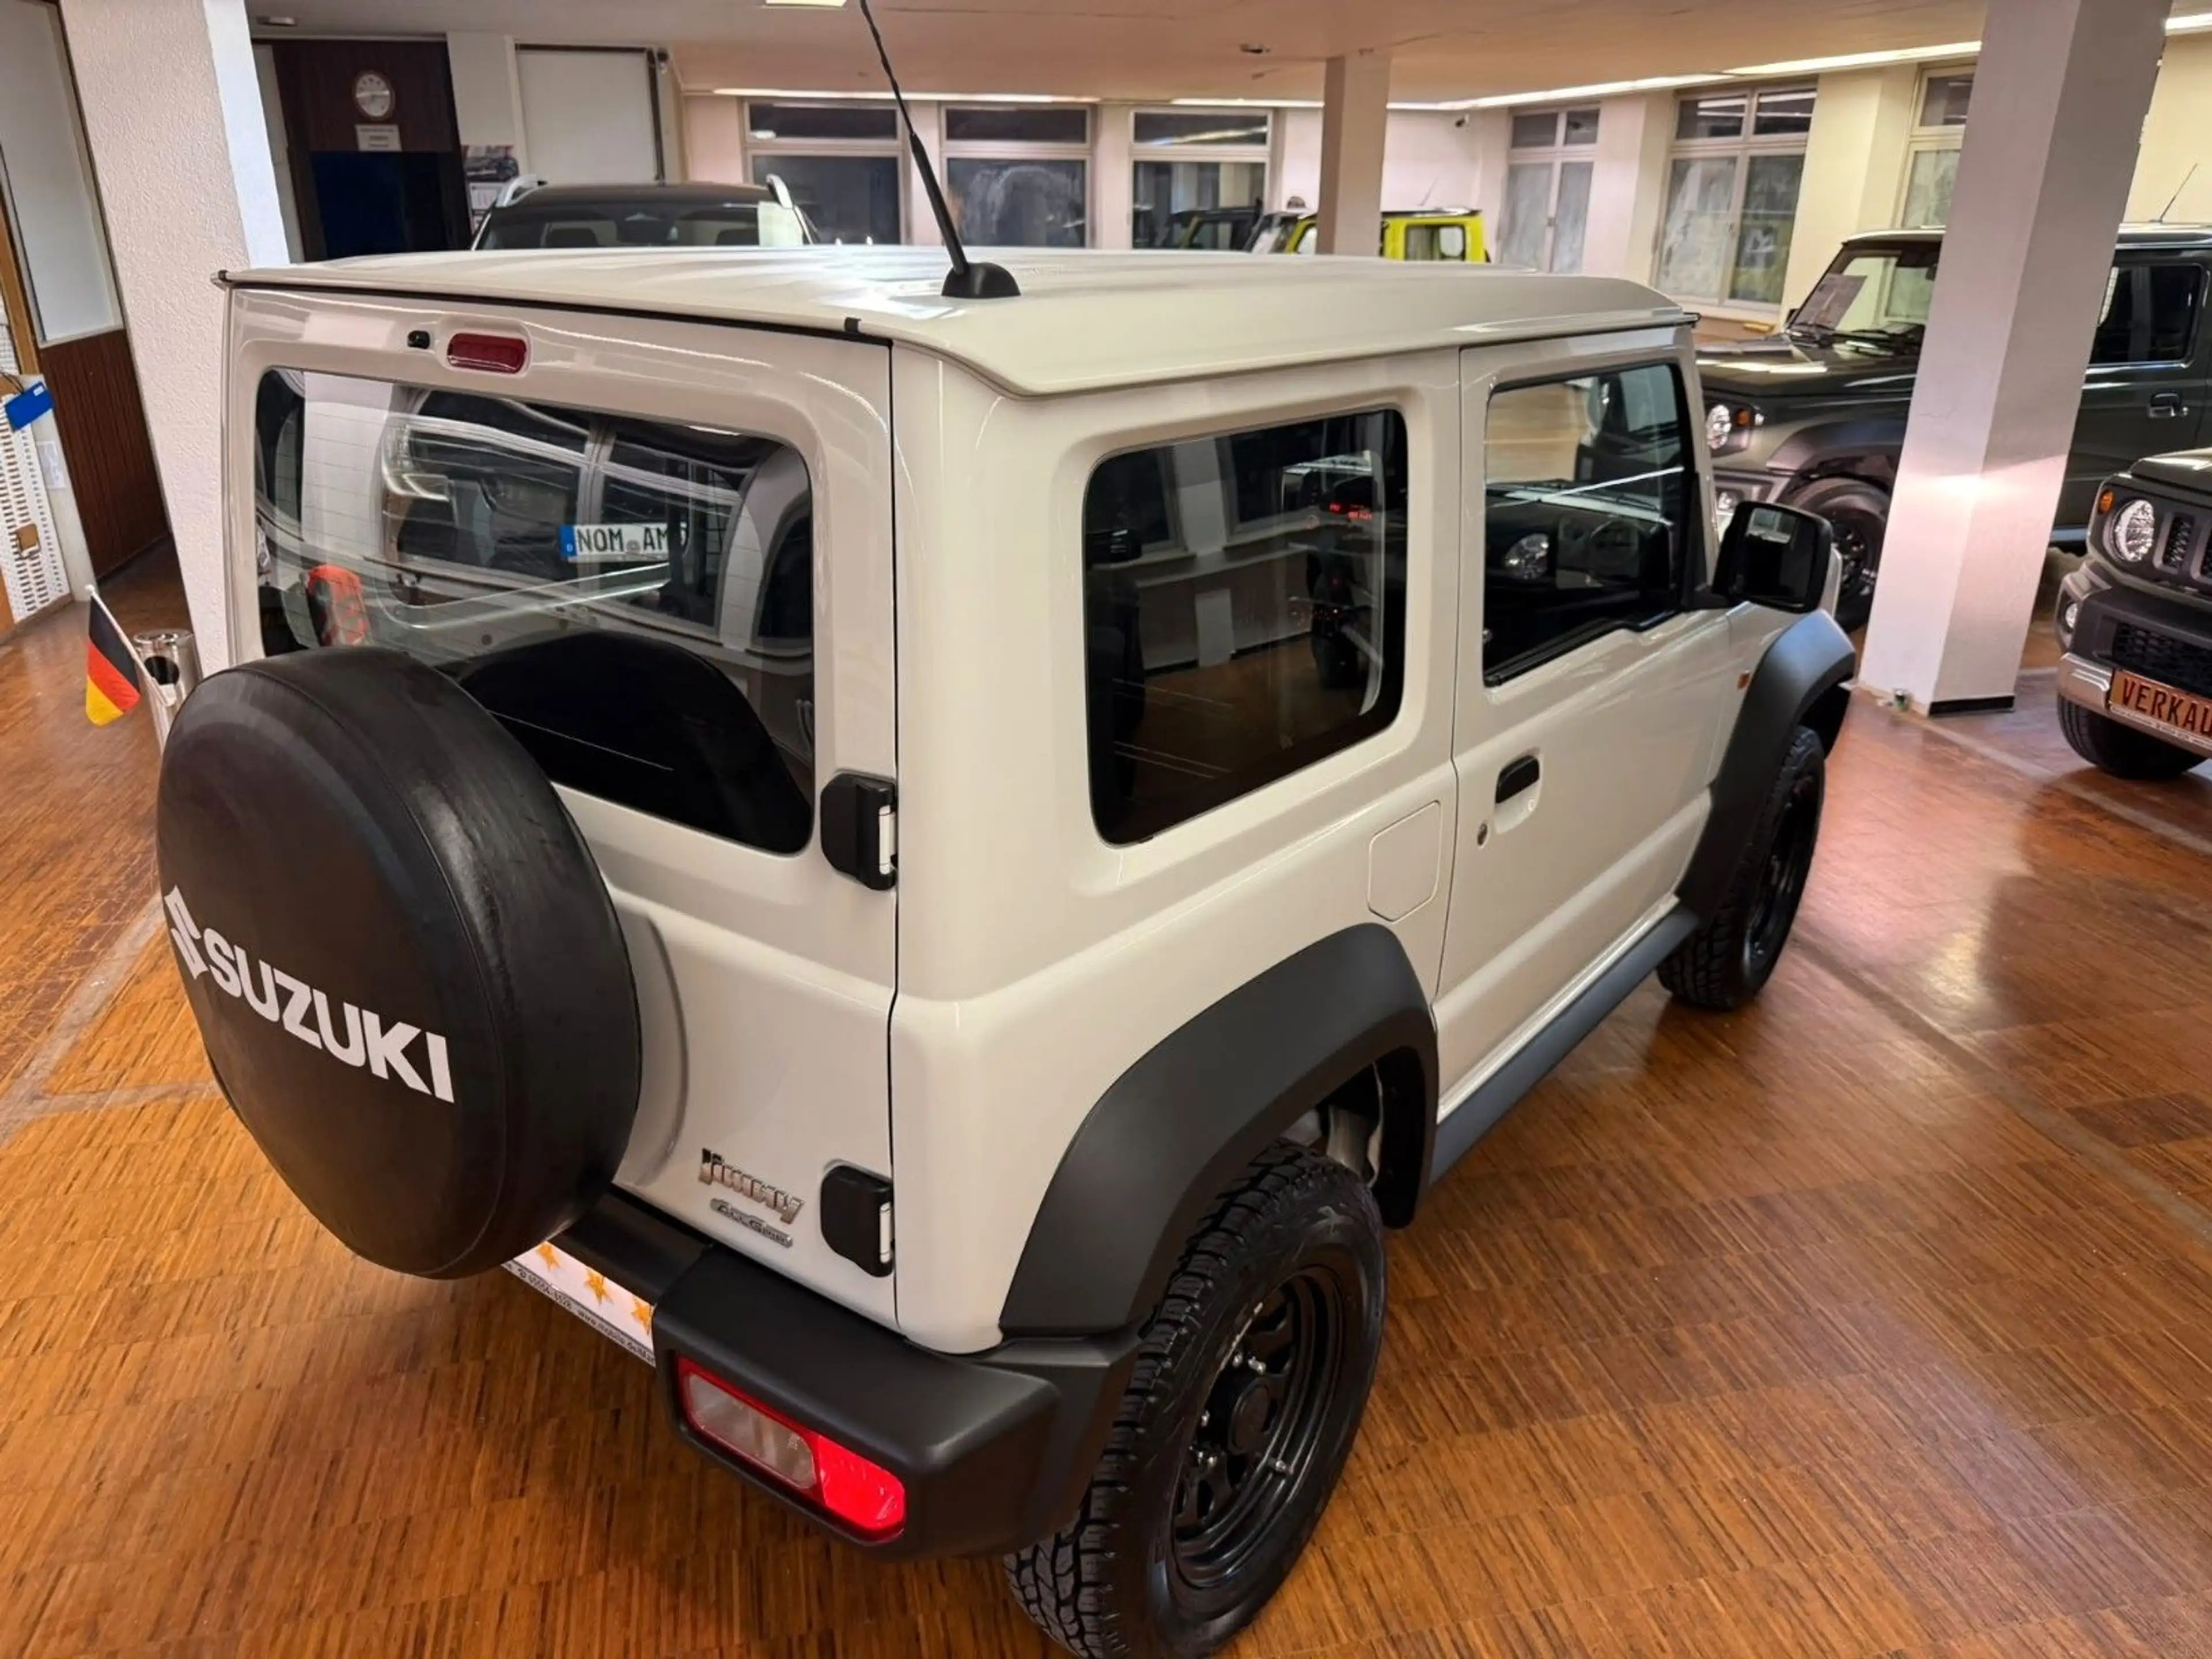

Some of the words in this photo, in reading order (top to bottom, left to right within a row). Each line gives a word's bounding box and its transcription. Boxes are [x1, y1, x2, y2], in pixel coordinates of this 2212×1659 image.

[577, 527, 624, 552] NOM
[2121, 677, 2212, 737] VERKAU
[203, 927, 455, 1104] SUZUKI
